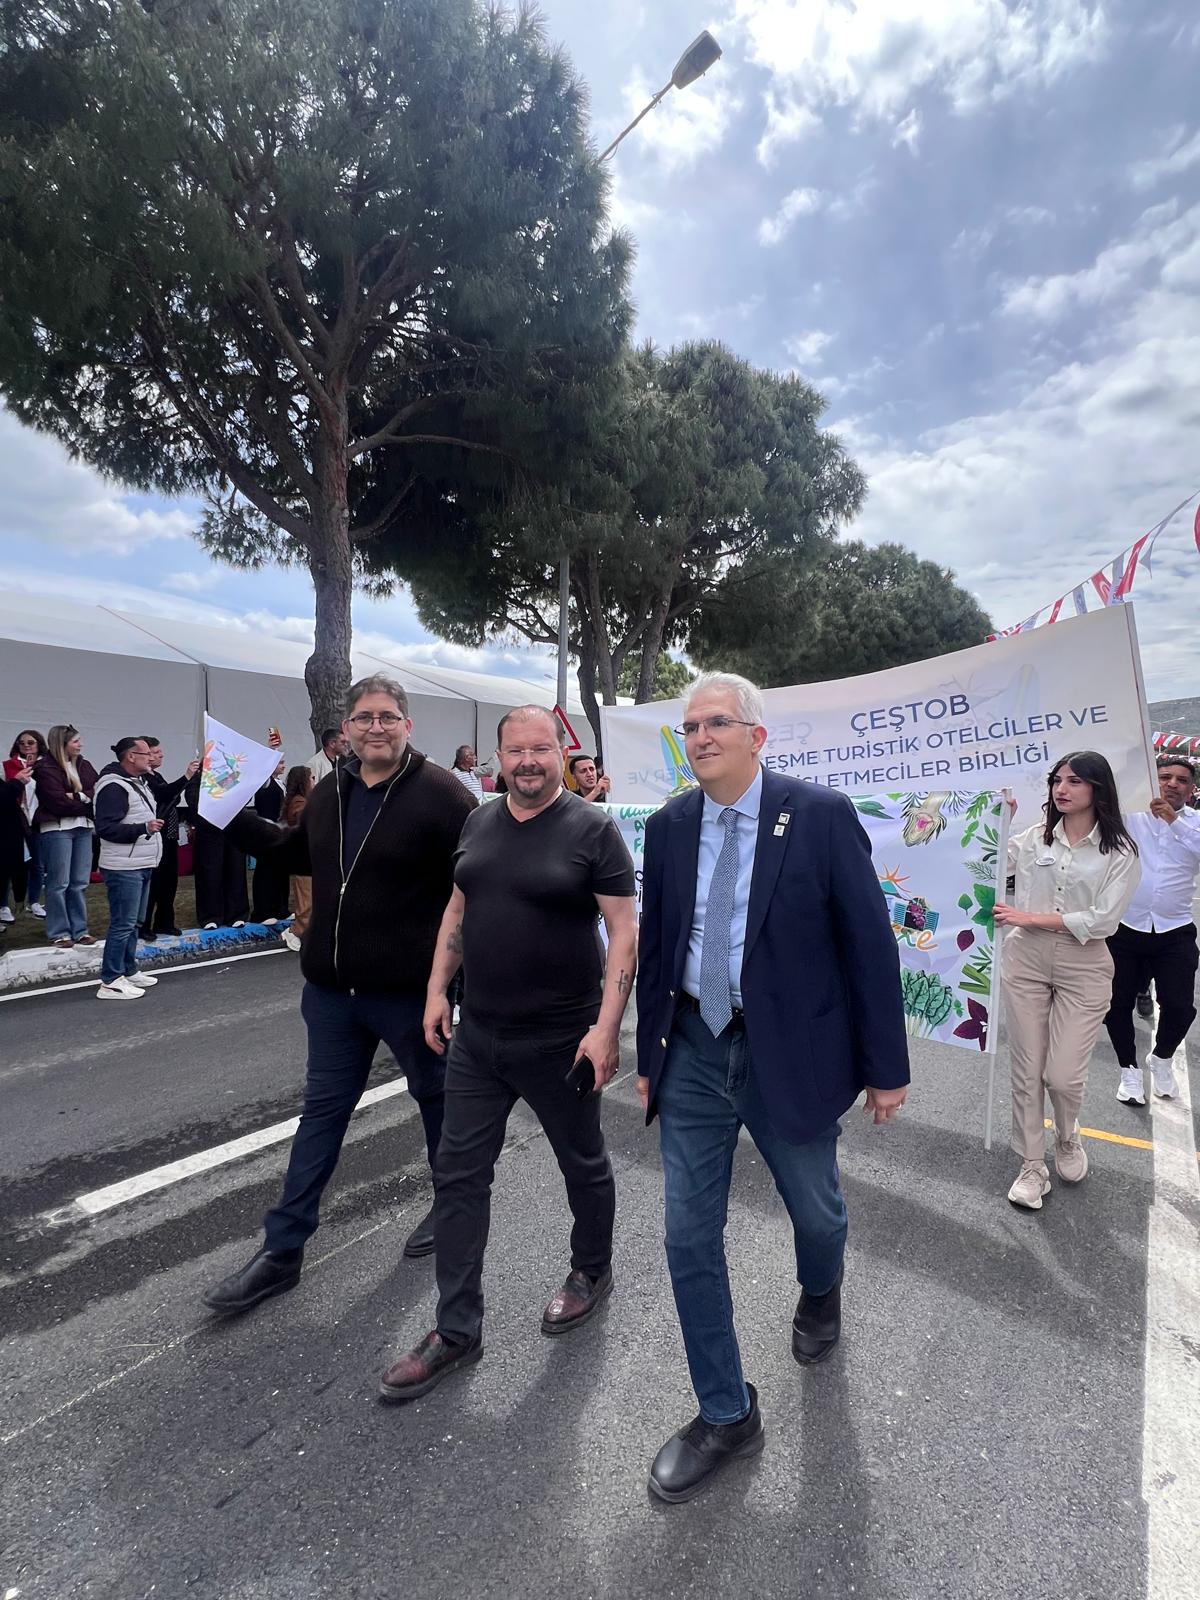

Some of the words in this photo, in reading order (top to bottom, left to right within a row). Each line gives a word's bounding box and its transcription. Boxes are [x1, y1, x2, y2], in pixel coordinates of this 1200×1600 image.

[765, 751, 818, 772] EŞME
[823, 736, 919, 763] TURİSTİK
[926, 717, 1063, 749] OTELCİLER
[1069, 705, 1108, 726] VE
[850, 694, 970, 737] ÇEŞTOB
[797, 759, 950, 788] ETMECİLER
[959, 741, 1049, 773] BİRLİĞİ
